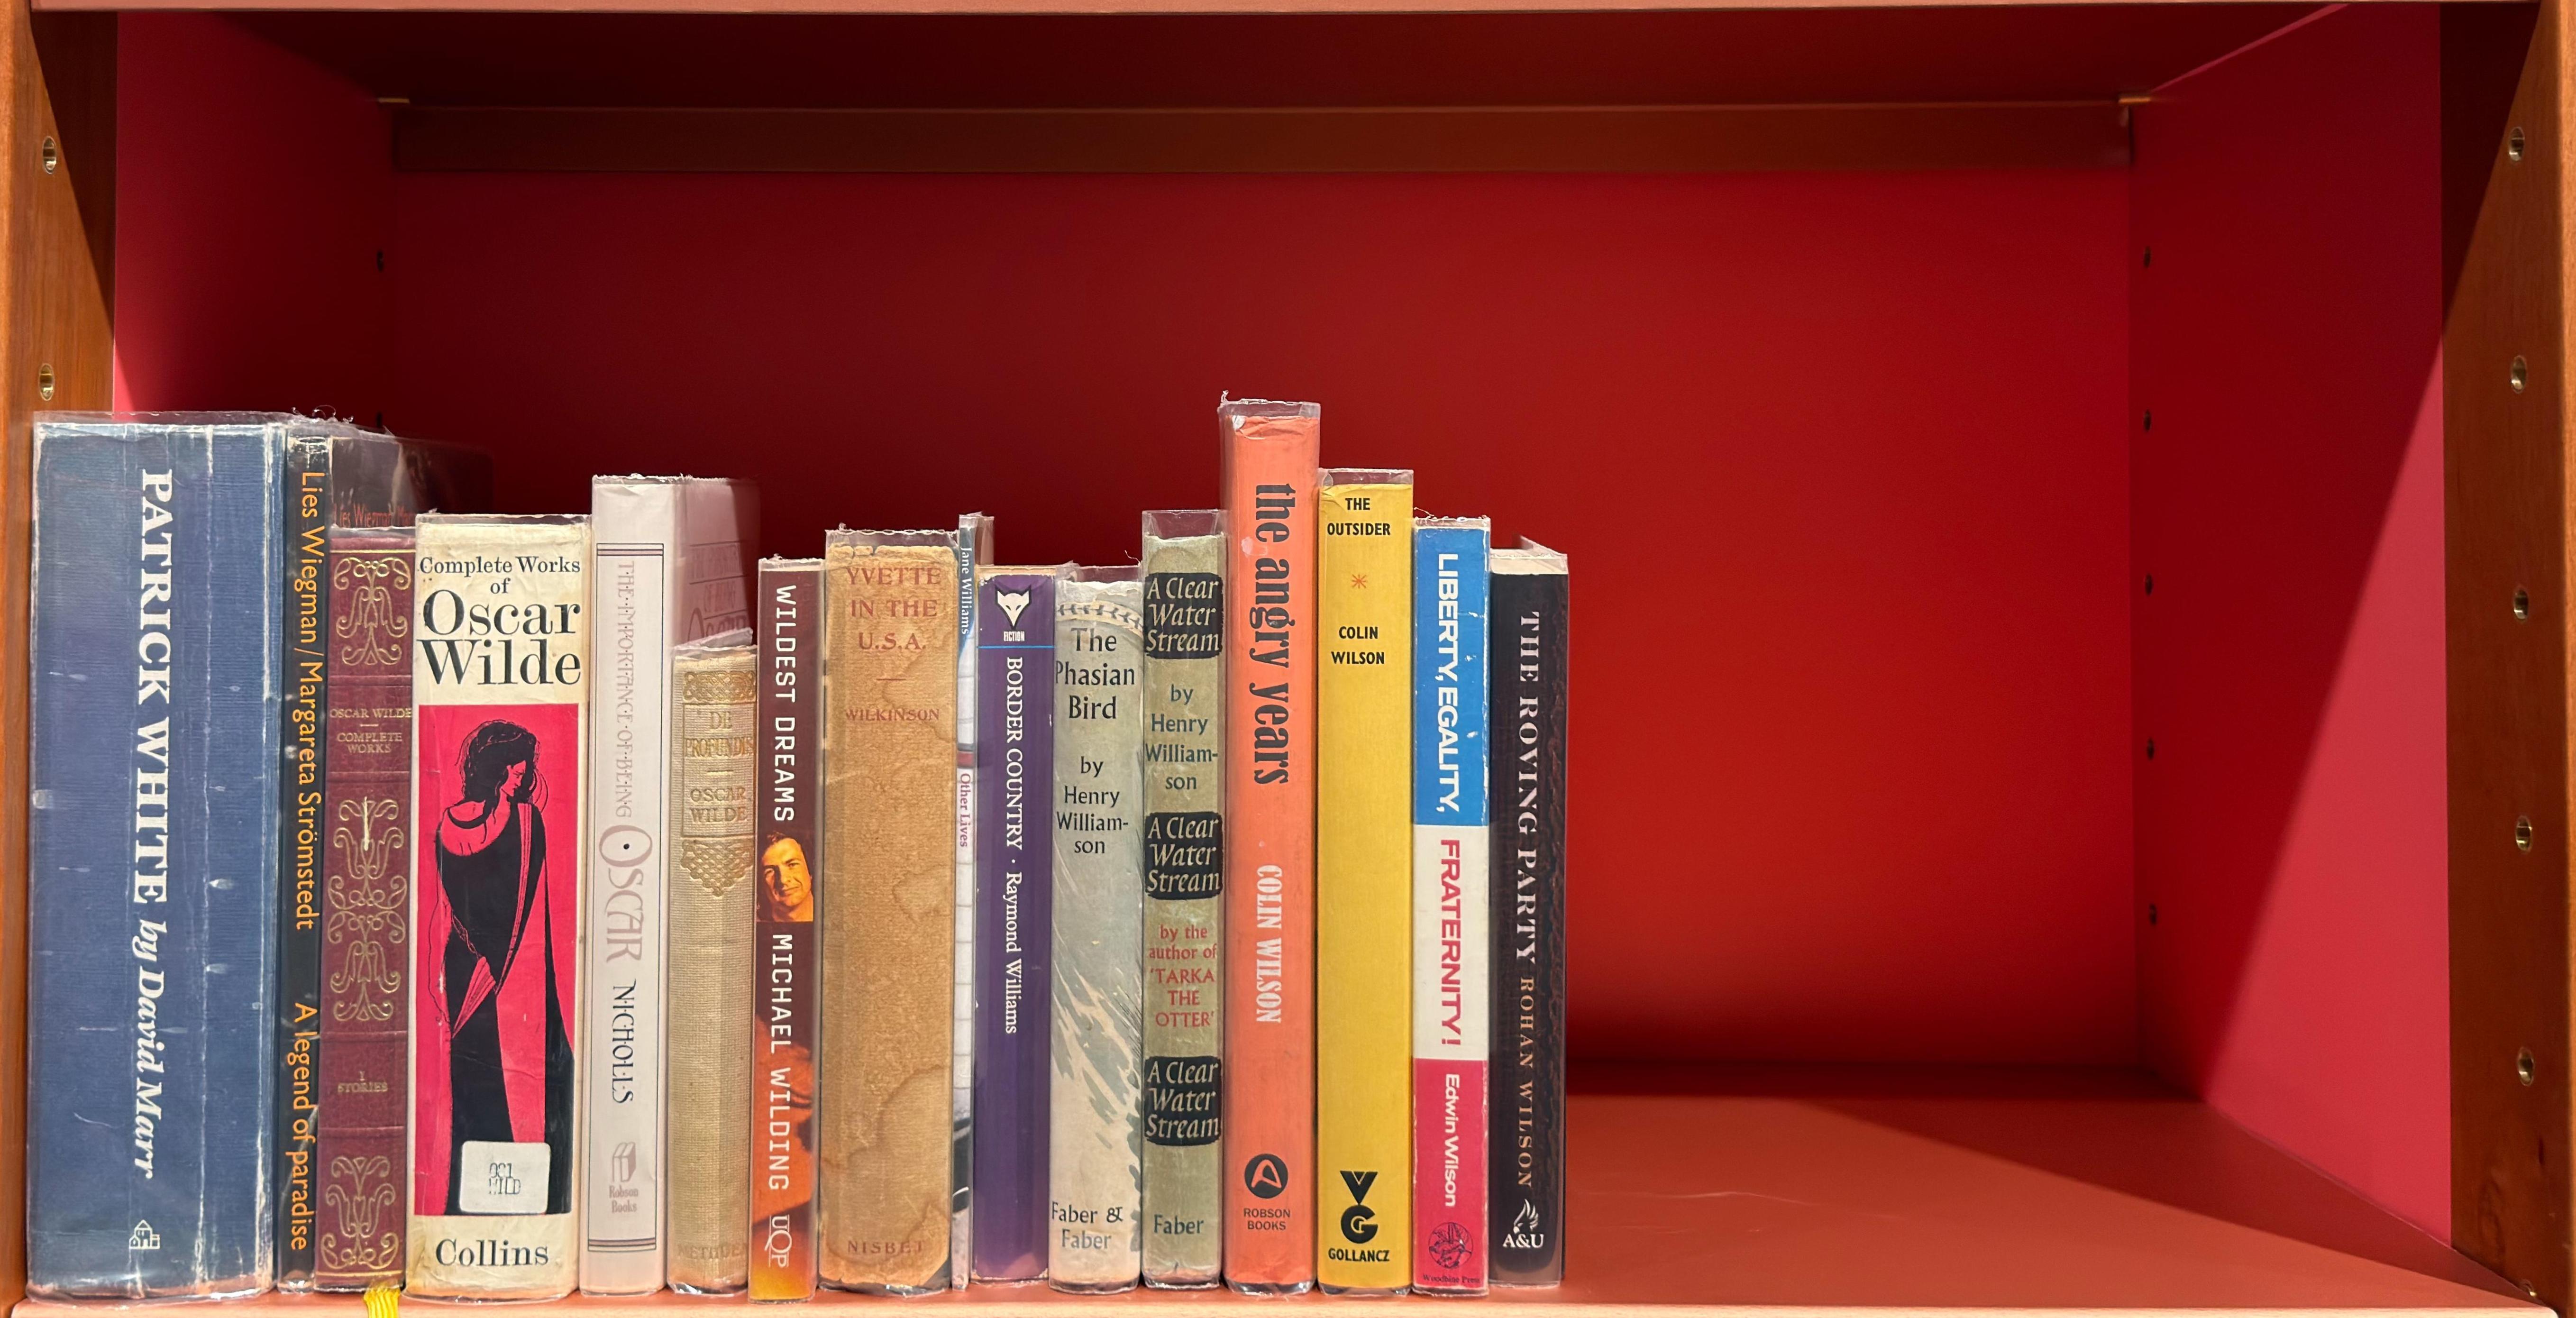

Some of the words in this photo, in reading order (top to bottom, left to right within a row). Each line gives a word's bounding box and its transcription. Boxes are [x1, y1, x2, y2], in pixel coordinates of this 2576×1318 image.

[301, 472, 325, 518] Lies
[1345, 498, 1370, 510] THE
[1255, 483, 1296, 543] the
[1327, 522, 1390, 535] OUTSIDER
[420, 556, 512, 577] Complete
[515, 556, 580, 573] Works
[960, 548, 972, 574] Jane
[137, 468, 173, 705] PATRICK
[293, 525, 325, 644] Wiegman
[490, 577, 511, 594] of
[846, 567, 941, 585] YVETTE
[1147, 577, 1160, 599] A
[1166, 577, 1219, 599] Clear
[423, 589, 581, 635] Oscar
[850, 599, 874, 617] IN
[886, 599, 938, 617] THE
[961, 578, 972, 634] Williams
[1148, 604, 1216, 626] Water
[1249, 558, 1295, 668] angry
[1435, 553, 1459, 682] LIBERTY,
[775, 585, 796, 703] WILDEST
[858, 632, 926, 650] U.S.A.
[1004, 631, 1024, 641] FICTION
[1071, 628, 1117, 651] The
[1146, 629, 1219, 652] Stream
[1339, 626, 1378, 639] COLIN
[1331, 651, 1385, 664] WILSON
[1519, 611, 1540, 682] THE
[416, 638, 581, 685] Wilde
[1056, 660, 1134, 685] Phasian
[1006, 657, 1023, 744] BORDER
[1170, 684, 1194, 705] by
[329, 708, 369, 718] OSCAR
[373, 708, 412, 718] WILDE
[845, 709, 940, 721] WILKINSON
[1069, 695, 1116, 719] Bird
[292, 661, 323, 785] Margareta
[711, 711, 732, 730] DE
[1151, 714, 1208, 735] Henry
[337, 732, 402, 742] COMPLETE
[1249, 682, 1289, 784] years
[347, 744, 392, 753] WORKS
[1145, 743, 1218, 762] William-
[1436, 687, 1460, 813] EGALITY,
[774, 717, 795, 821] DREAMS
[1081, 756, 1104, 778] by
[1517, 696, 1539, 834] ROVING
[690, 787, 747, 802] OSCAR
[960, 773, 971, 810] Other
[1165, 776, 1197, 790] son
[1006, 749, 1023, 850] COUNTRY
[1065, 786, 1120, 807] Henry
[134, 717, 169, 904] WHITE
[689, 806, 747, 823] WILDE
[1057, 812, 1128, 831] William-
[960, 814, 970, 847] Lives
[1148, 817, 1161, 839] A
[1167, 817, 1219, 839] Clear
[1075, 840, 1105, 853] son
[1150, 843, 1216, 866] Water
[294, 792, 320, 930] Strömstedt
[1147, 870, 1220, 892] Stream
[599, 824, 653, 963] OSCAR
[1257, 865, 1282, 929] COLIN
[1002, 872, 1023, 952] Raymond
[1516, 849, 1536, 964] PARTY
[132, 920, 167, 960] by
[1160, 924, 1178, 942] by
[1185, 925, 1207, 939] the
[1441, 840, 1461, 1045] FRATERNITY!
[1149, 945, 1197, 960] author
[1203, 943, 1217, 959] of
[1256, 937, 1282, 1023] WILSON
[770, 934, 793, 1054] MICHAEL
[1005, 959, 1022, 1034] Williams
[1168, 990, 1200, 1006] THE
[137, 966, 164, 1074] David
[294, 1003, 318, 1023] A
[1519, 976, 1535, 1068] ROHAN
[287, 1031, 318, 1110] legend
[1147, 1061, 1161, 1083] A
[1166, 1061, 1218, 1083] Clear
[338, 1081, 388, 1092] STORIES
[1149, 1088, 1216, 1111] Water
[1445, 1073, 1460, 1134] Edwin
[133, 1080, 162, 1180] Marr
[292, 1119, 316, 1144] of
[768, 1068, 791, 1191] WILDING
[1146, 1114, 1219, 1138] Stream
[1517, 1081, 1533, 1187] WILSON
[1445, 1135, 1459, 1207] Wilson
[285, 1151, 314, 1250] paradise
[609, 1185, 639, 1199] Robson
[612, 1200, 637, 1213] Books
[1052, 1201, 1098, 1223] Faber
[1106, 1207, 1124, 1223] &
[1243, 1208, 1290, 1217] ROBSON
[1154, 1214, 1204, 1234] Faber
[1248, 1221, 1286, 1230] BOOKS
[848, 1240, 924, 1254] NISBET
[1062, 1229, 1112, 1249] Faber
[1502, 1233, 1544, 1248] A&U
[436, 1238, 549, 1267] Collins
[1328, 1248, 1389, 1262] GOLLANCZ
